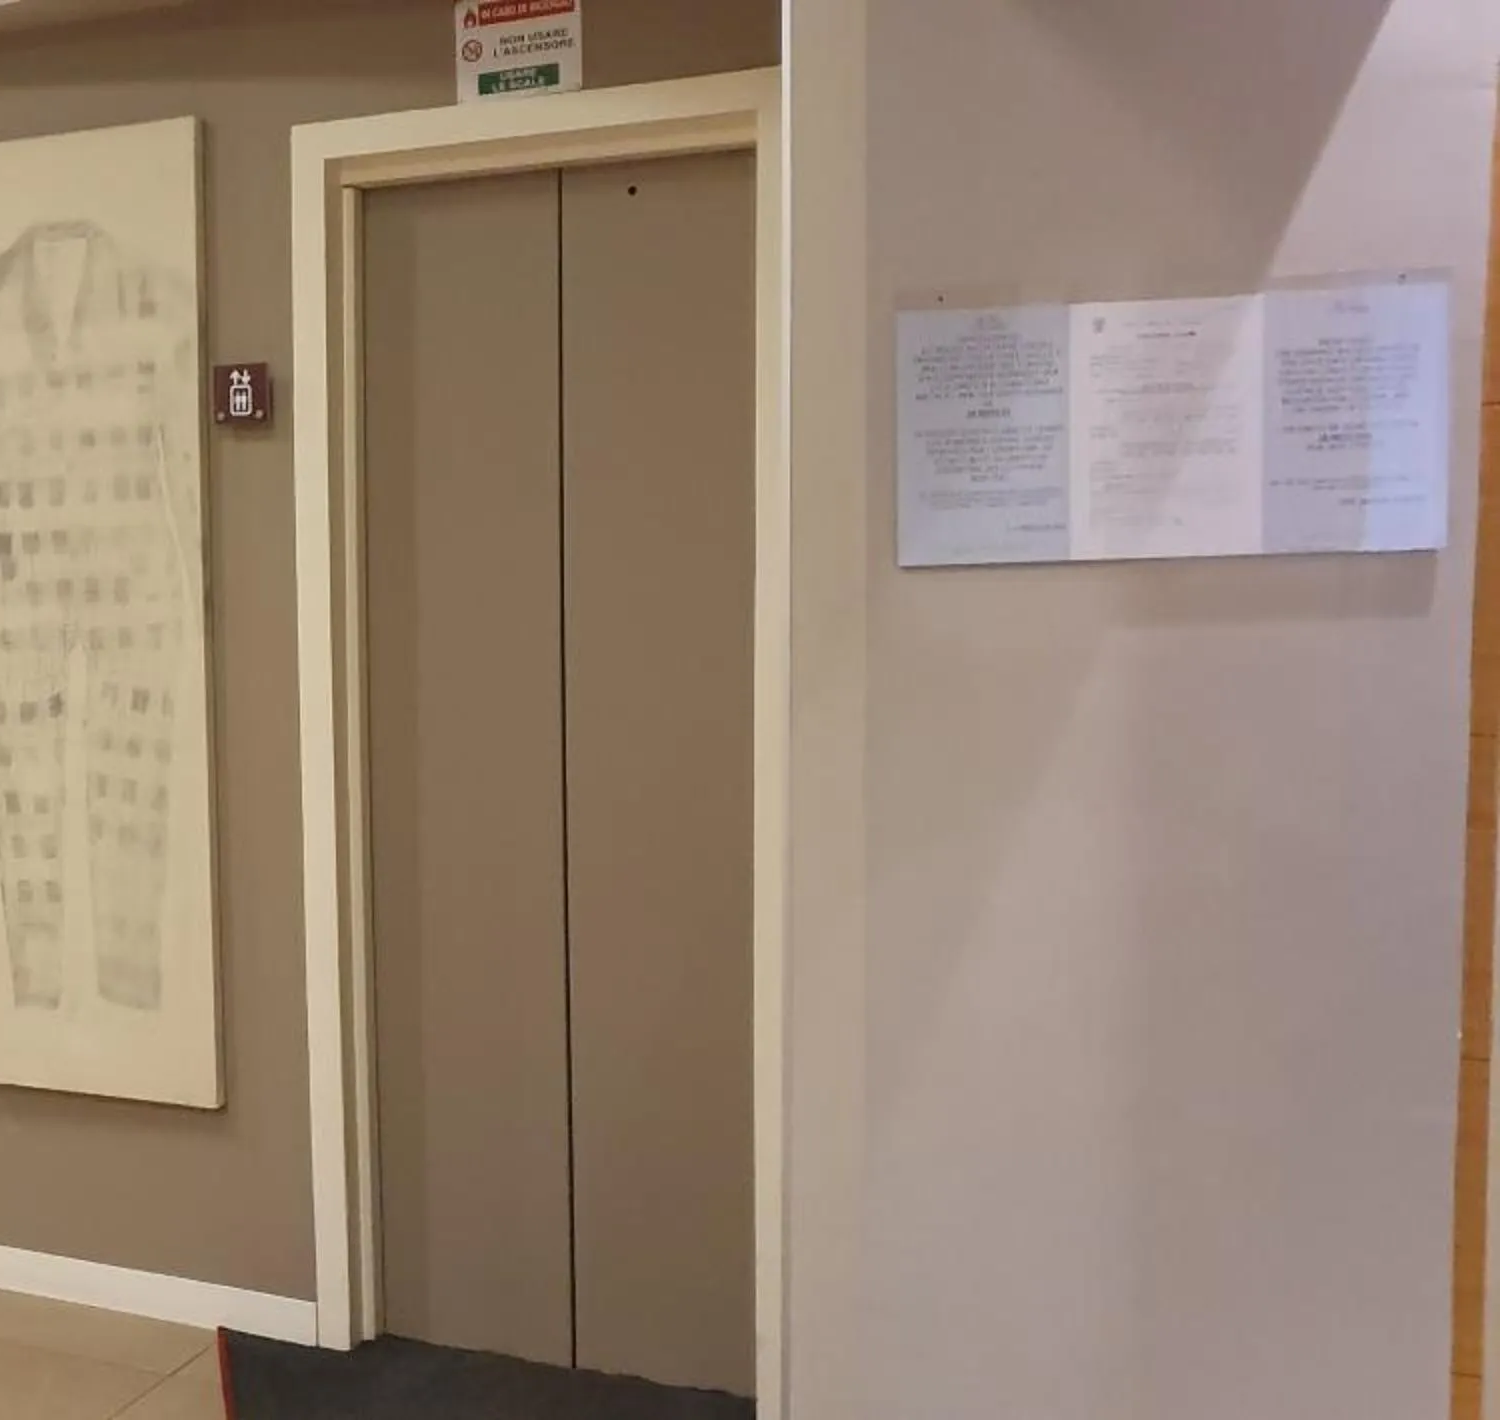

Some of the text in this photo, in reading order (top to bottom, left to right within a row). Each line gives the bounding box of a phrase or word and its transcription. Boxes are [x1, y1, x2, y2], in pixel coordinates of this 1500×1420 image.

[499, 28, 568, 46] NON USARE
[493, 38, 574, 58] L'ASCENSORE
